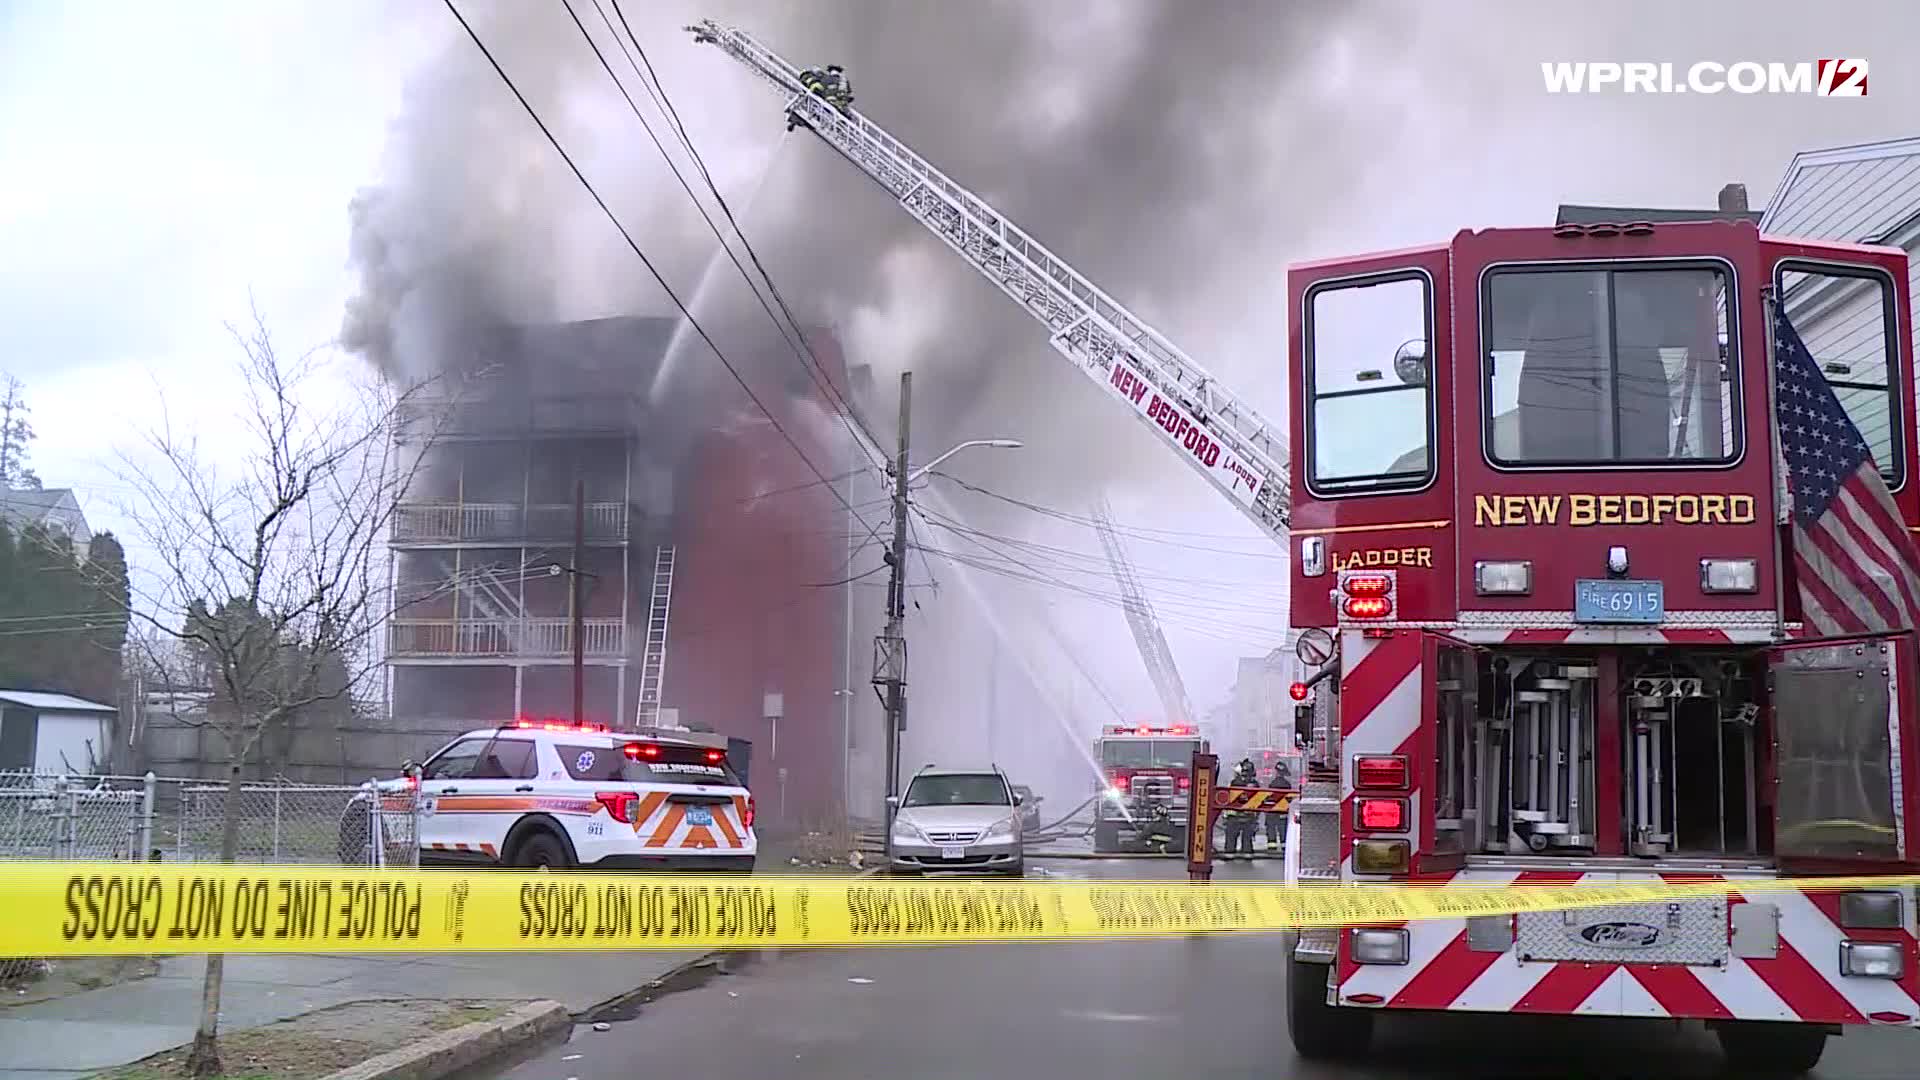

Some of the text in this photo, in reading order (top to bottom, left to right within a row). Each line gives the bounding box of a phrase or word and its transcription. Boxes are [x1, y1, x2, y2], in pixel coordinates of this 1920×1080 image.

[1109, 363, 1221, 468] NEW BEDFORD
[1222, 455, 1257, 493] LADDER
[1473, 493, 1756, 527] NEW BEDFORD
[1332, 546, 1433, 572] LADDER
[1582, 588, 1659, 612] FIRE 6915
[587, 826, 604, 836] 911
[1193, 778, 1207, 853] PULL PIN
[63, 875, 162, 940] CROSS
[168, 877, 224, 938] NOT
[232, 878, 268, 938] DO
[275, 879, 332, 938] LINE
[340, 881, 422, 938] POLICE
[519, 881, 587, 938] CROSS
[592, 882, 632, 937] NOT
[638, 884, 664, 937] DO
[670, 883, 709, 937] LINE
[716, 883, 776, 937] POLICE
[847, 887, 901, 936] CROSS
